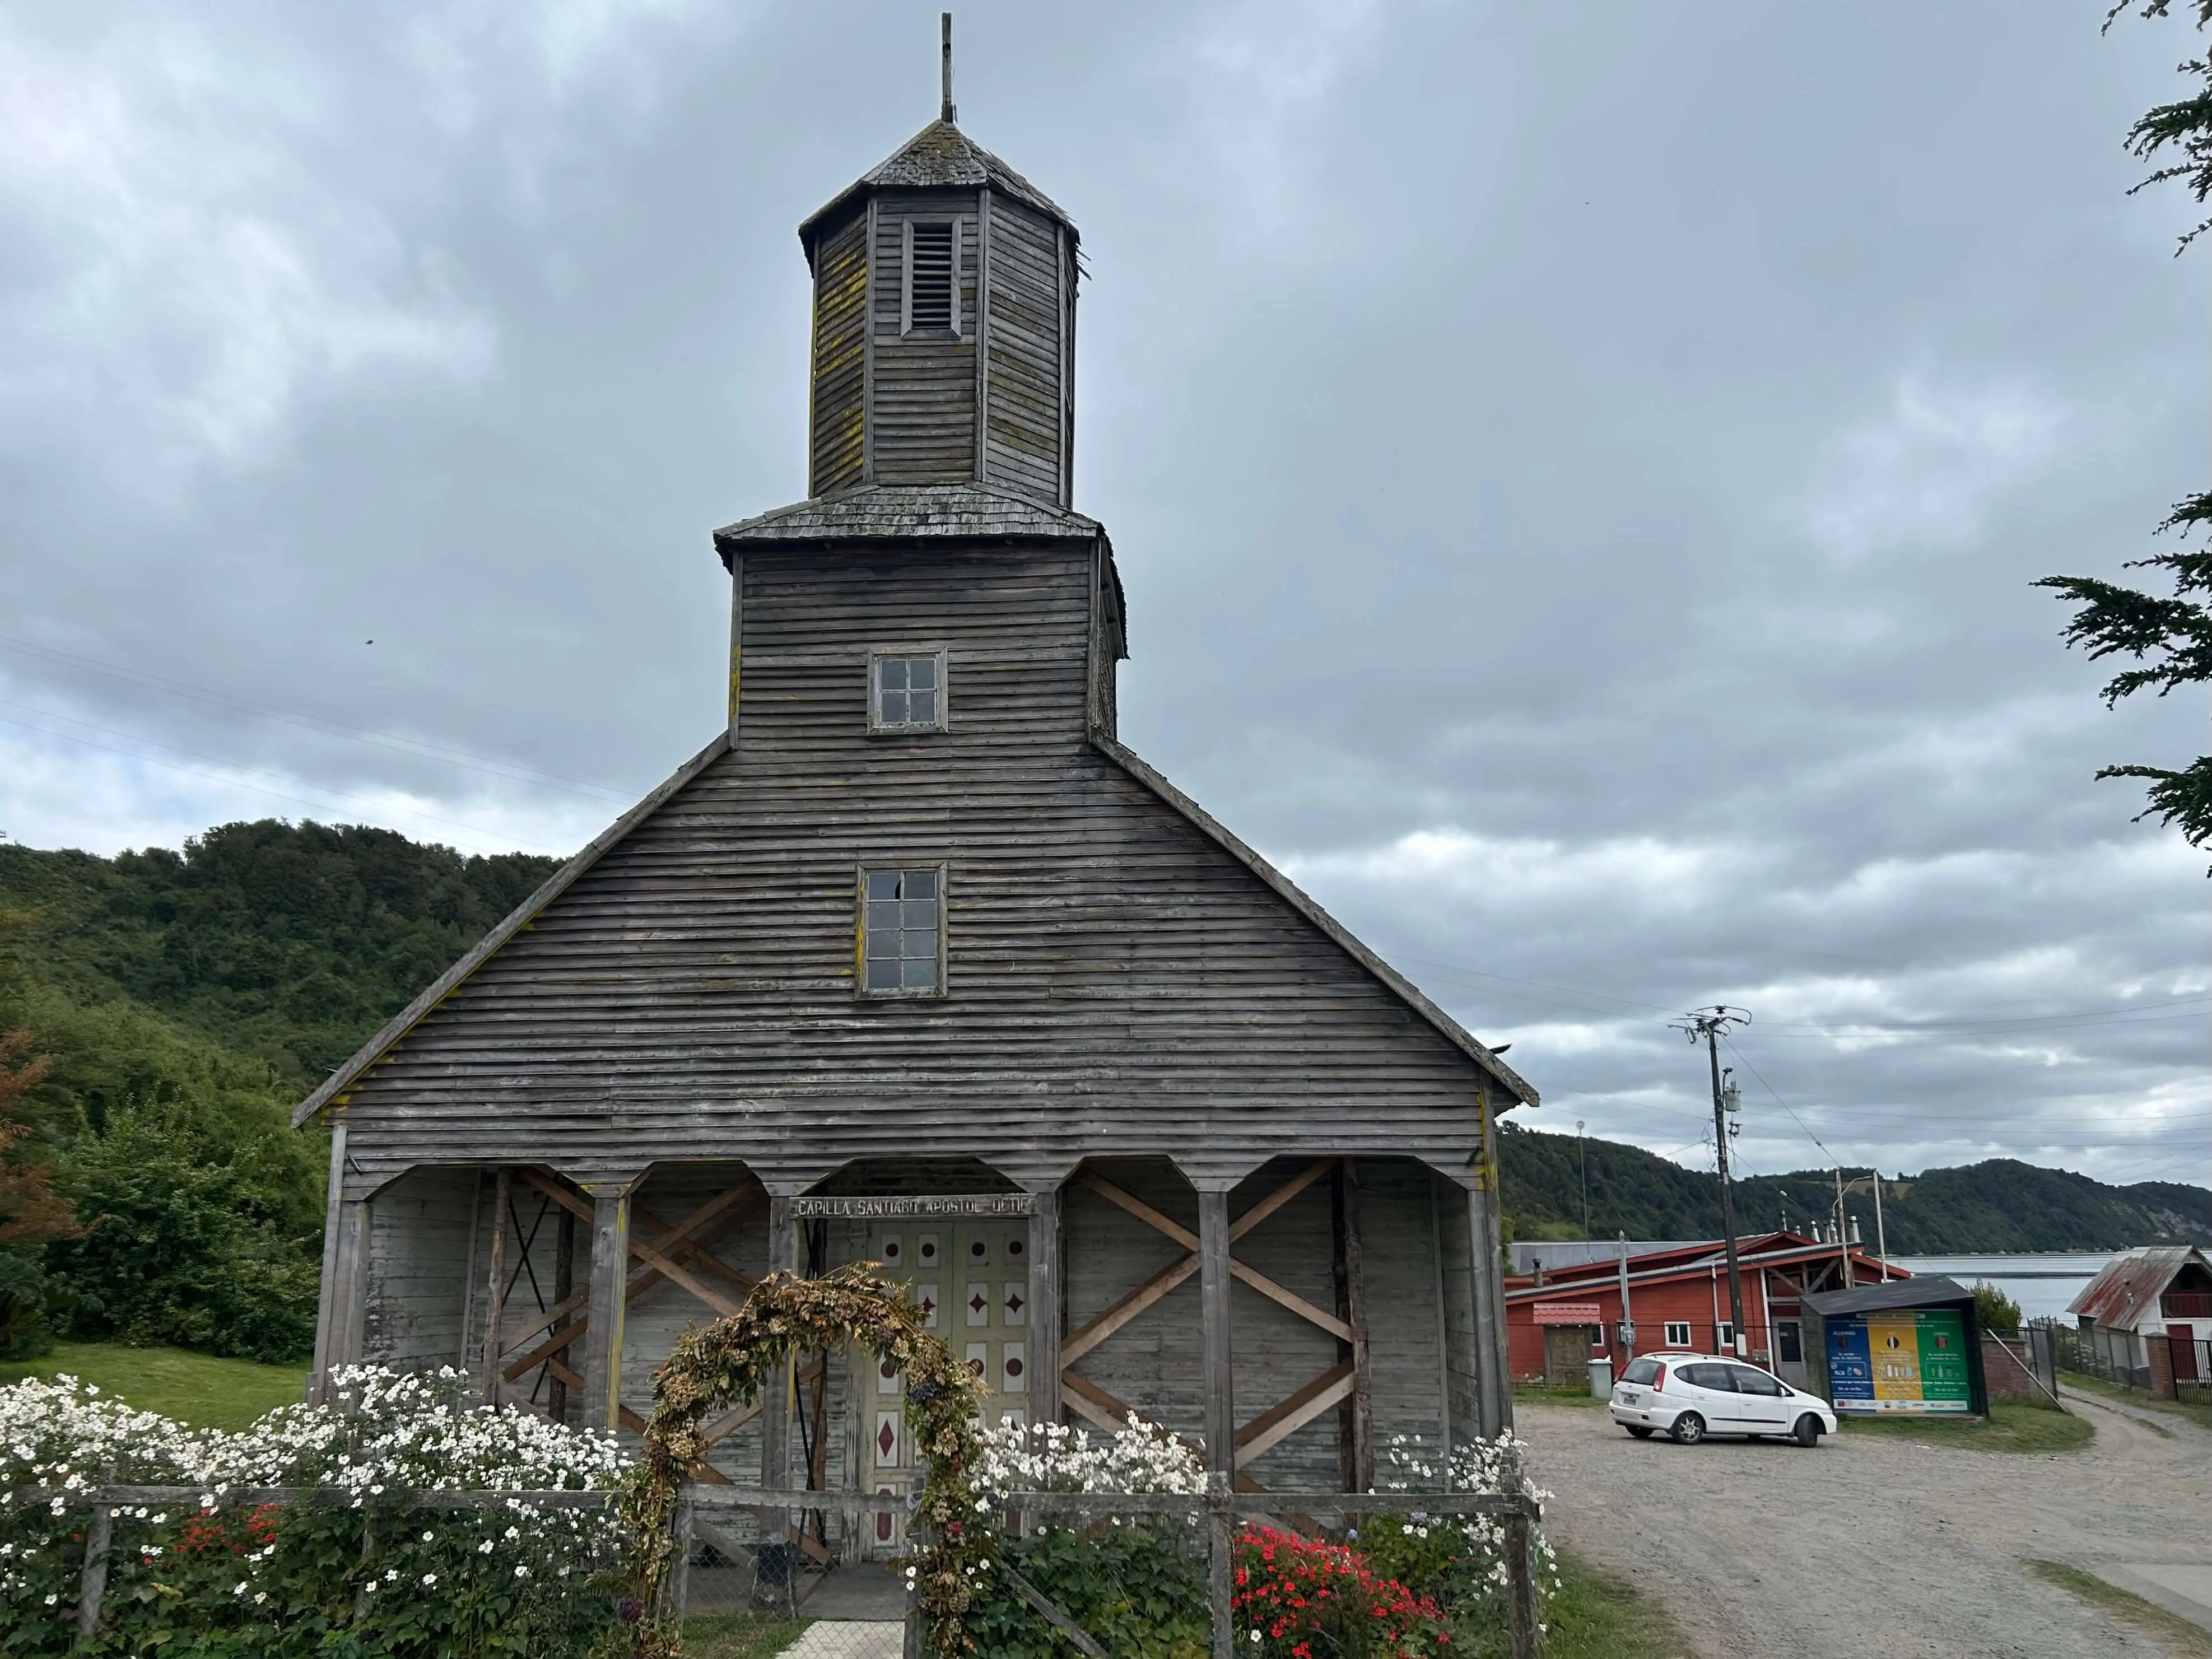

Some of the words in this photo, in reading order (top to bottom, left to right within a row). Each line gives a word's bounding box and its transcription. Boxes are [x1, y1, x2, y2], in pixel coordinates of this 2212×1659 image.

[798, 1200, 850, 1215] CAPILLA
[858, 1200, 918, 1215] SANTIAGO
[926, 1198, 980, 1214] APOSTOL
